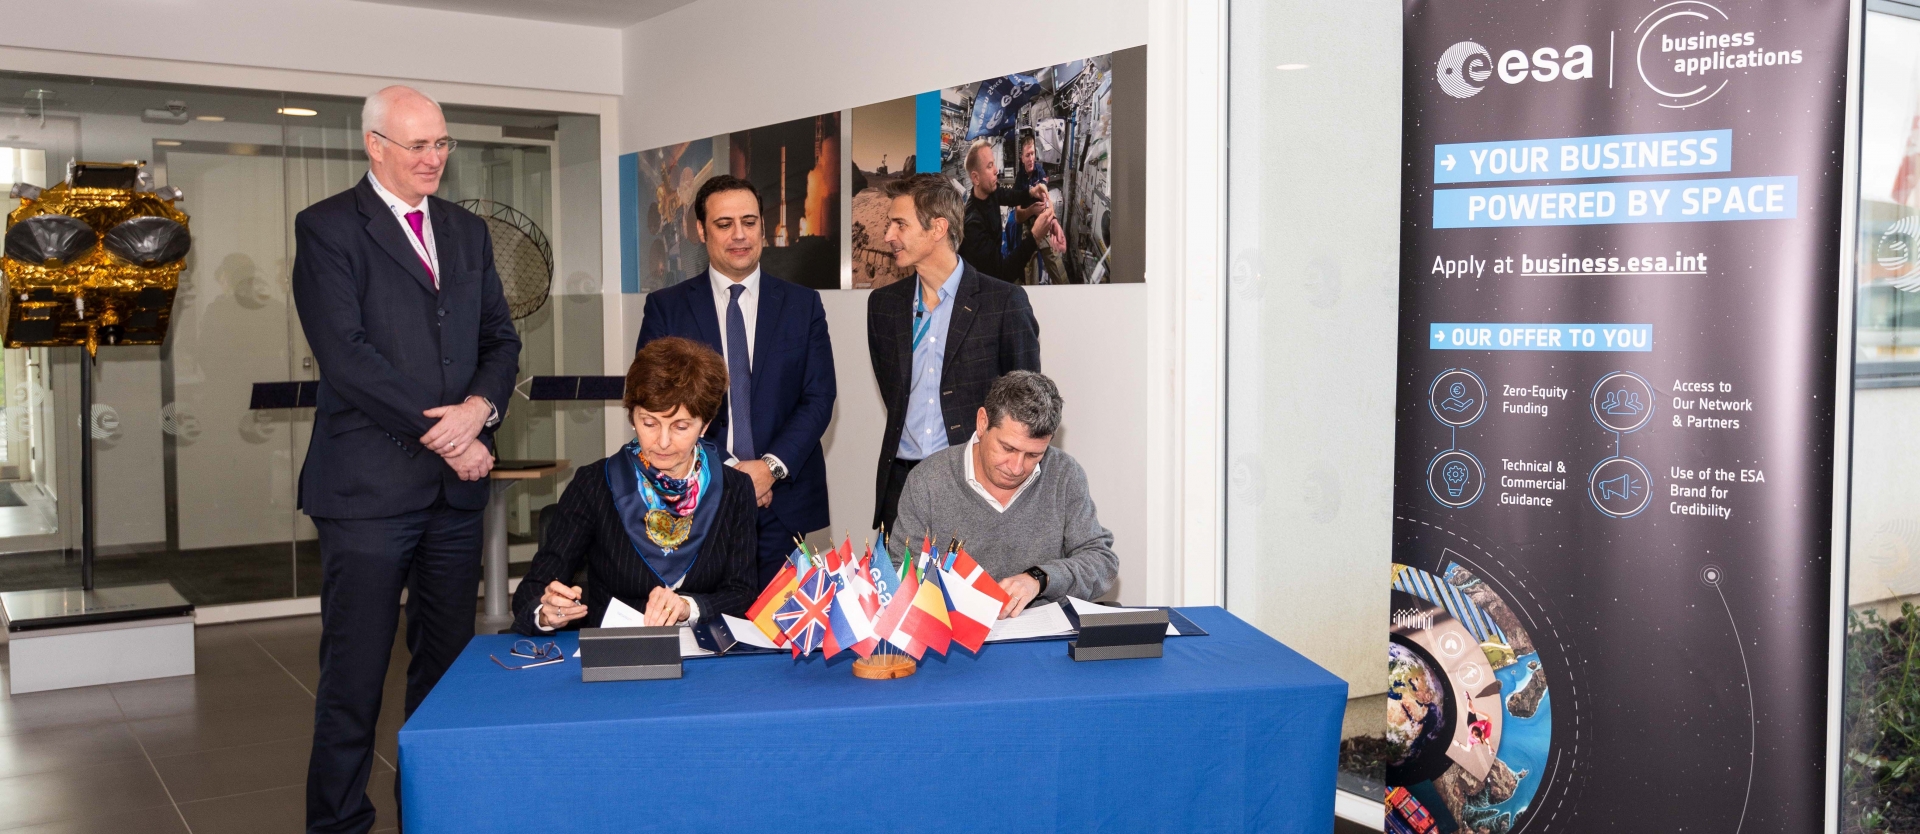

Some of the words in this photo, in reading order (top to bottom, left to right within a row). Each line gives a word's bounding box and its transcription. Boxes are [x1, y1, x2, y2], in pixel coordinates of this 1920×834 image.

[1661, 30, 1755, 53] business
[1498, 43, 1594, 84] esa
[1674, 48, 1803, 75] applications
[1470, 146, 1549, 175] YOUR
[1560, 138, 1718, 171] BUSINESS
[1469, 191, 1616, 221] POWERED
[1628, 189, 1670, 217] BY
[1682, 184, 1784, 215] SPACE
[1431, 255, 1486, 278] Apply
[1493, 256, 1514, 274] at
[1521, 251, 1708, 277] business.esa.int
[1451, 328, 1492, 346] OUR
[1498, 329, 1561, 347] OFFER
[1569, 329, 1596, 347] TO
[1603, 329, 1647, 348] YOU
[1503, 384, 1568, 402] Zero-Equity
[1672, 379, 1715, 393] Access
[1719, 380, 1732, 394] to
[1503, 401, 1549, 417] Funding
[1672, 397, 1695, 411] Our
[1699, 398, 1753, 412] Network
[1672, 415, 1683, 428] &
[1687, 415, 1740, 430] Partners
[1502, 459, 1552, 473] Technical
[1556, 460, 1567, 473] &
[1670, 467, 1695, 481] Use
[1698, 467, 1712, 481] of
[1714, 468, 1736, 482] the
[1740, 468, 1765, 483] ESA
[1501, 476, 1566, 490] Commercial
[1670, 484, 1707, 499] Brand
[1710, 485, 1728, 500] for
[1500, 492, 1553, 507] Guidance
[1670, 502, 1732, 520] Credibility
[870, 567, 893, 606] esa
